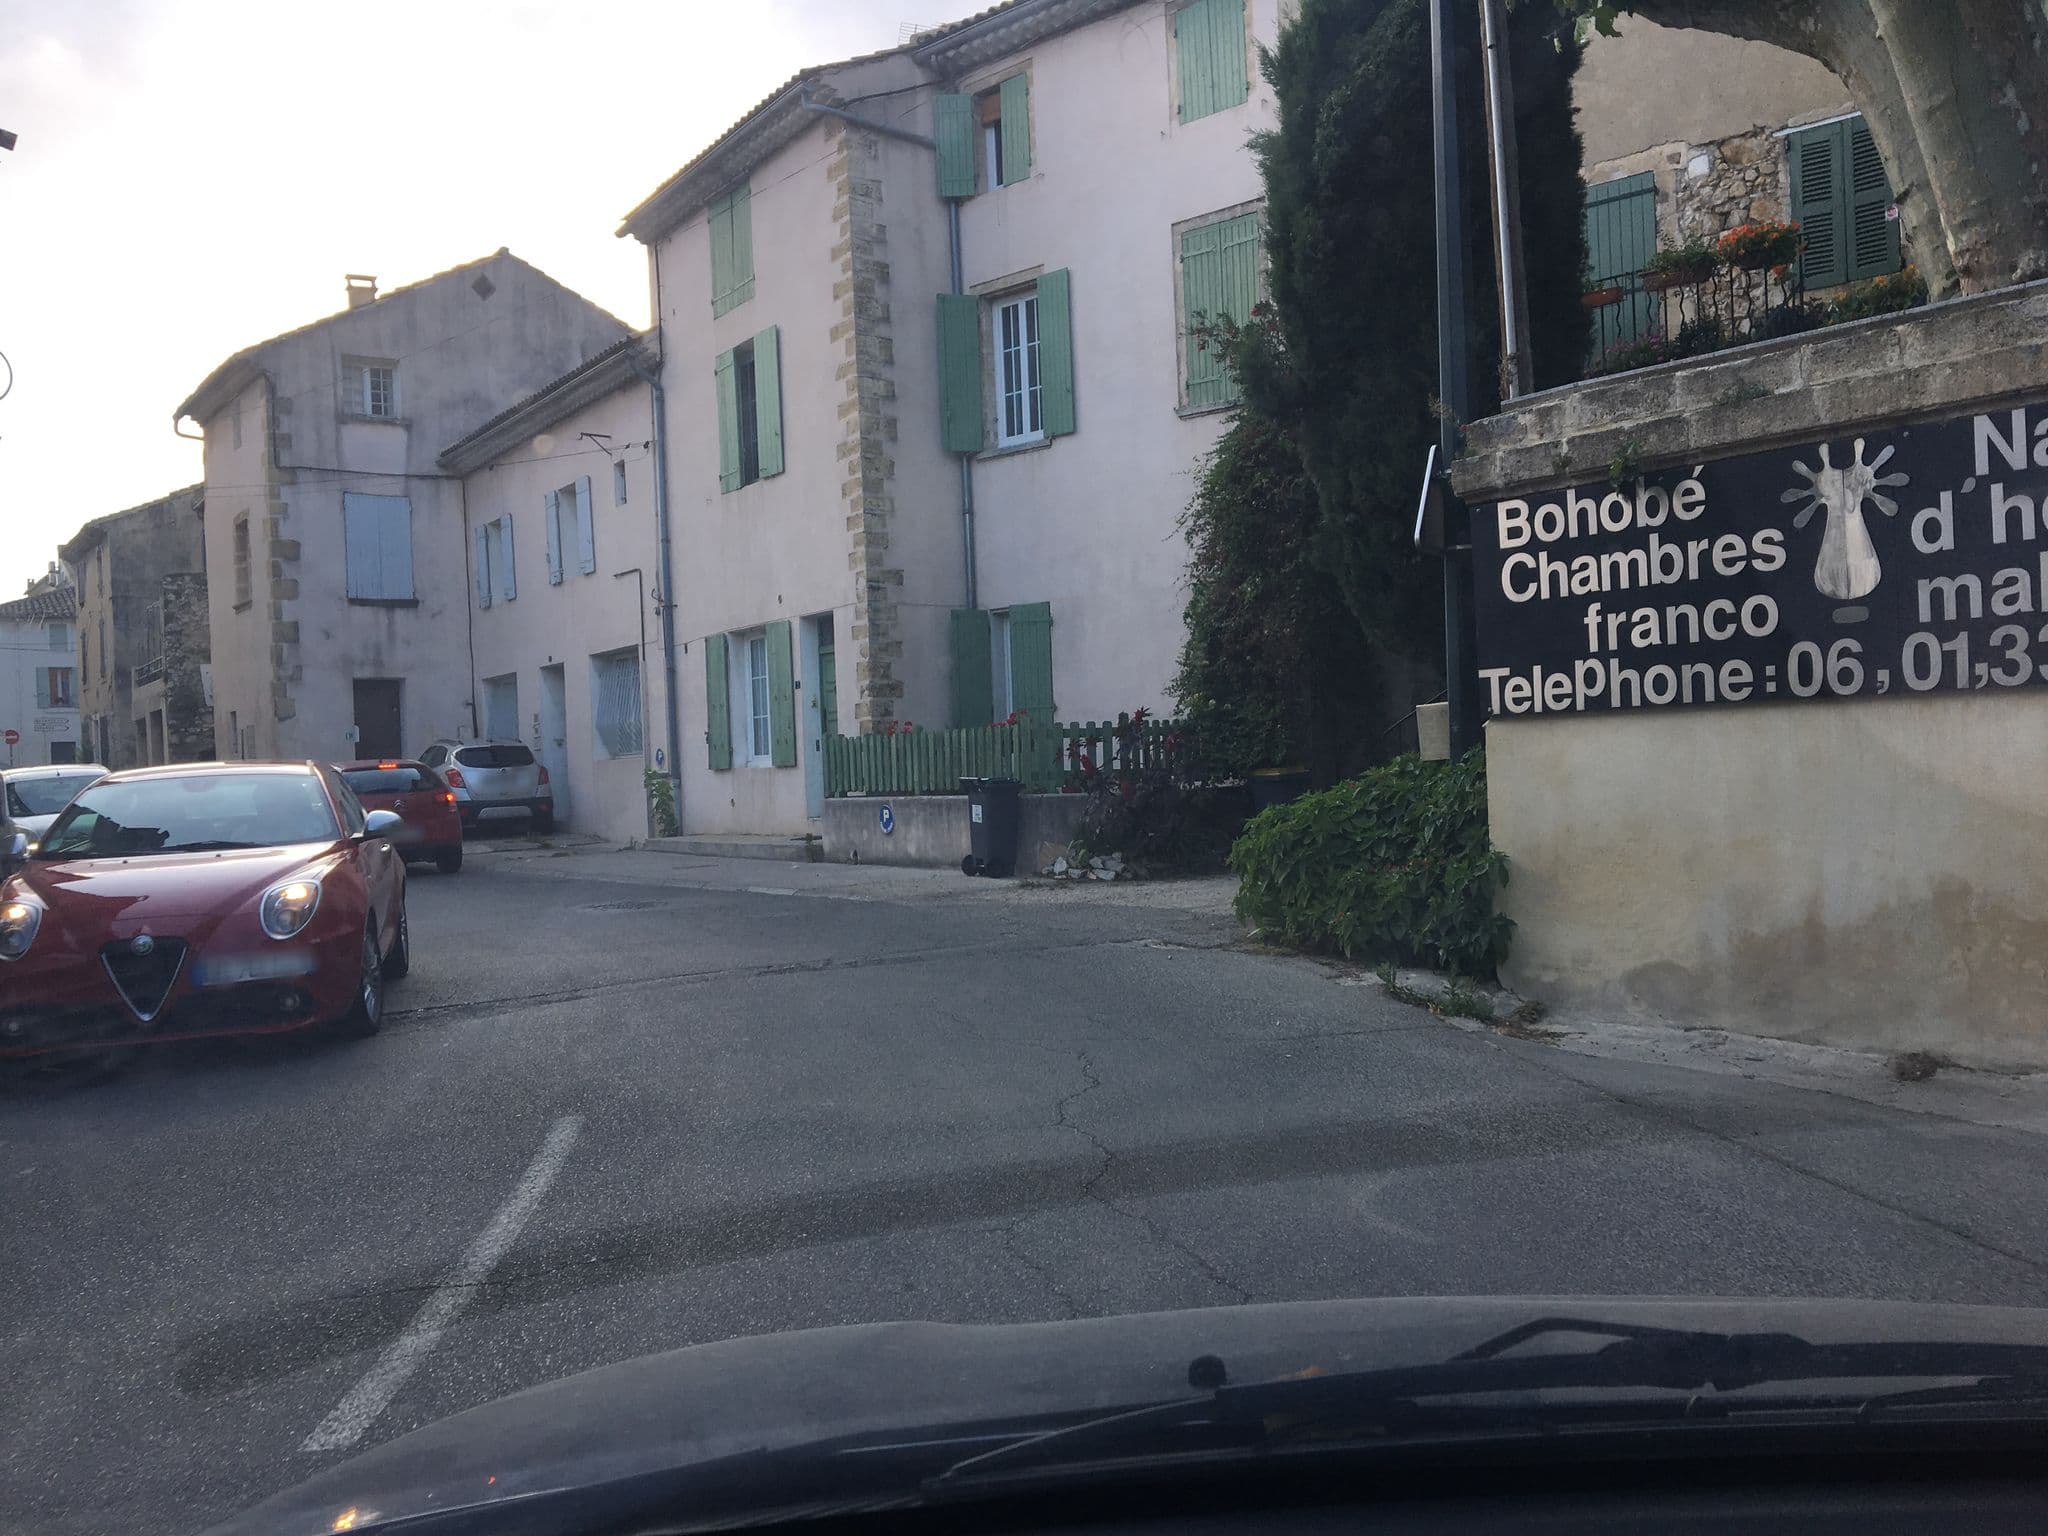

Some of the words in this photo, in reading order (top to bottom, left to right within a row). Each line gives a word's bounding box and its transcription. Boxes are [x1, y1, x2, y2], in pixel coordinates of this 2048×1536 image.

[1497, 465, 1706, 549] Bohobé
[1501, 528, 1787, 603] Chambres
[1910, 482, 2048, 554] d'h
[1583, 594, 1779, 653] franco
